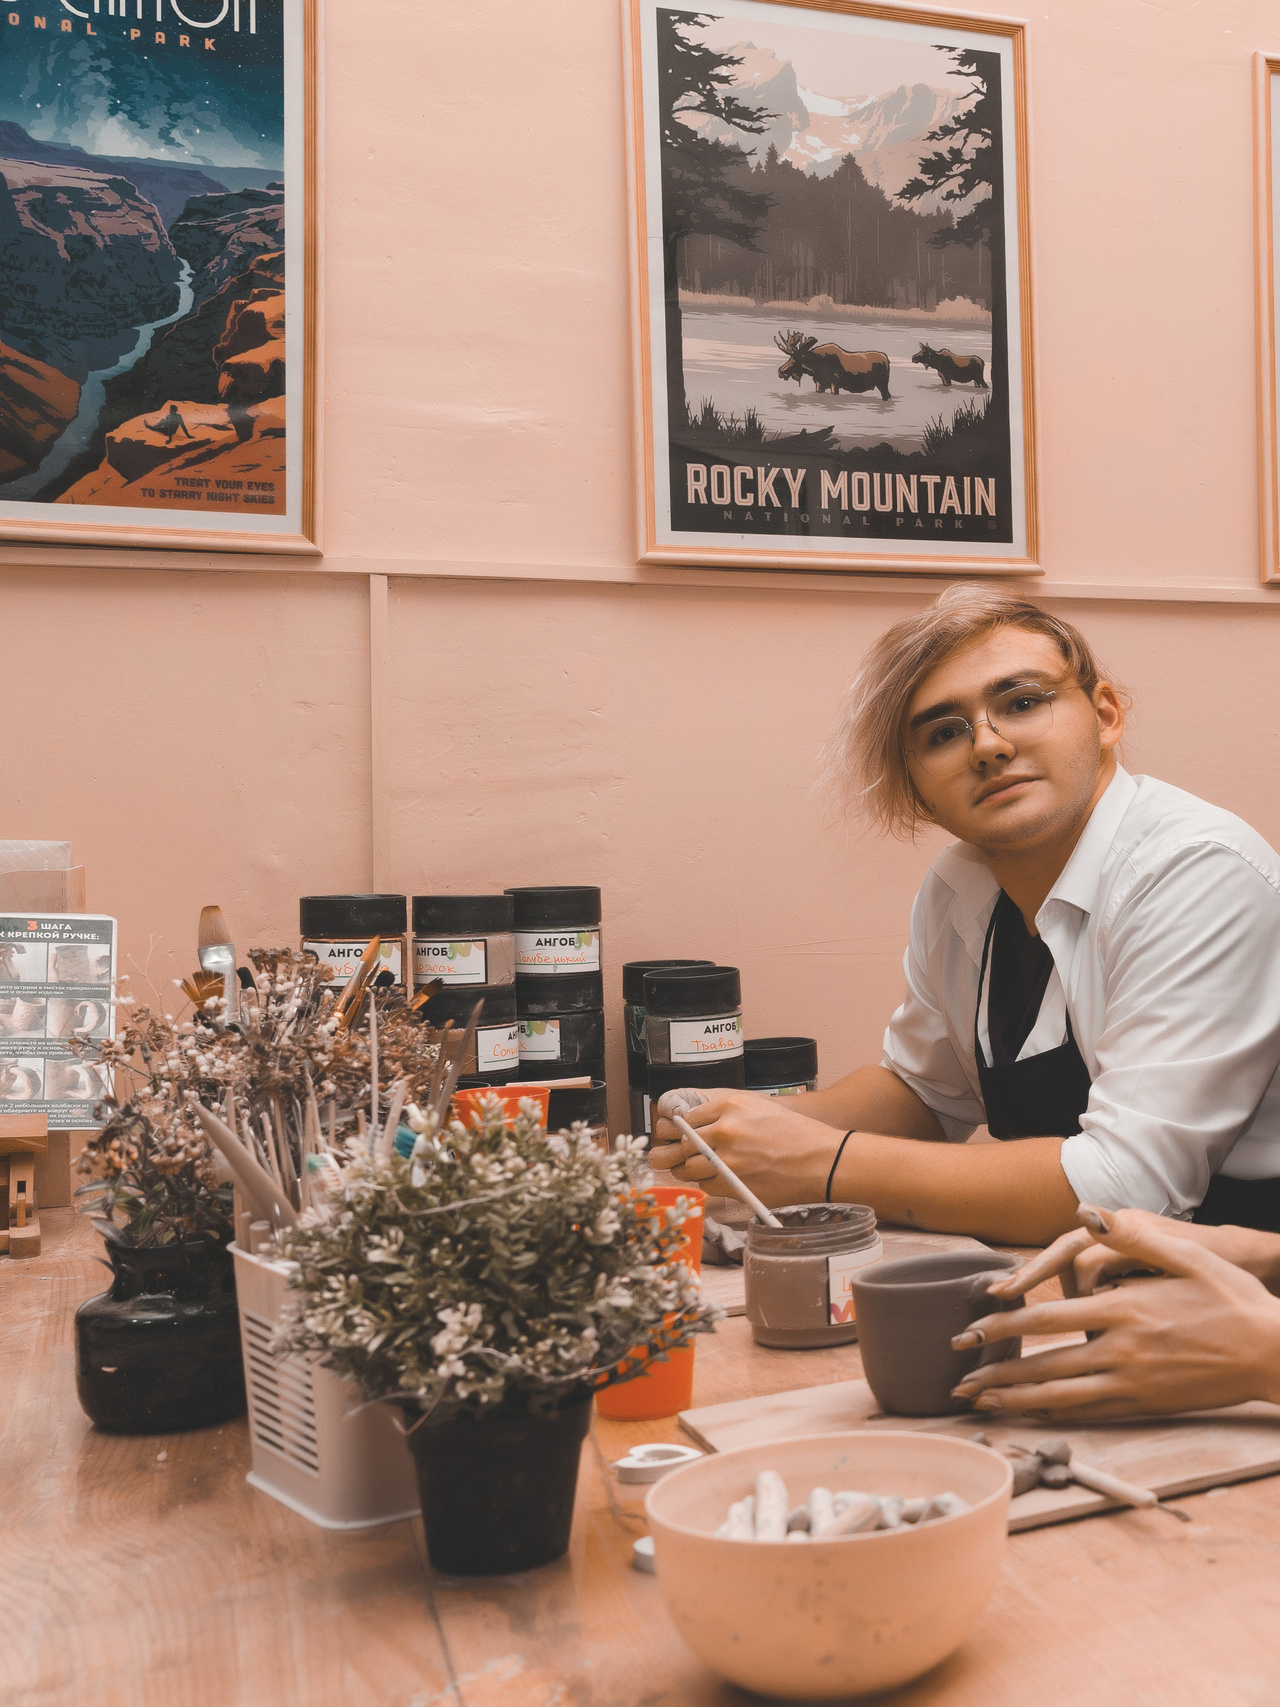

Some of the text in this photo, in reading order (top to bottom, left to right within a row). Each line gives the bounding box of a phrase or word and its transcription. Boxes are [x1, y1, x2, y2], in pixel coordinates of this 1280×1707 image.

[130, 28, 216, 51] PARK
[174, 476, 275, 492] TREAT YOUR EYES
[686, 463, 997, 517] ROCKY MOUNTAIN
[140, 487, 275, 505] TO STARRY NIGHT SKIES
[724, 510, 964, 530] NATIONAL PARK
[26, 920, 72, 931] 3 ШАГА
[8, 930, 60, 939] КРЕПКОЙ
[62, 932, 100, 940] РУЧКЕ:
[535, 937, 575, 947] АНГОБ
[328, 948, 366, 958] АНГО
[416, 947, 448, 957] АНГОБ
[703, 1021, 737, 1035] АНГОБ
[691, 1037, 735, 1052] Трава
